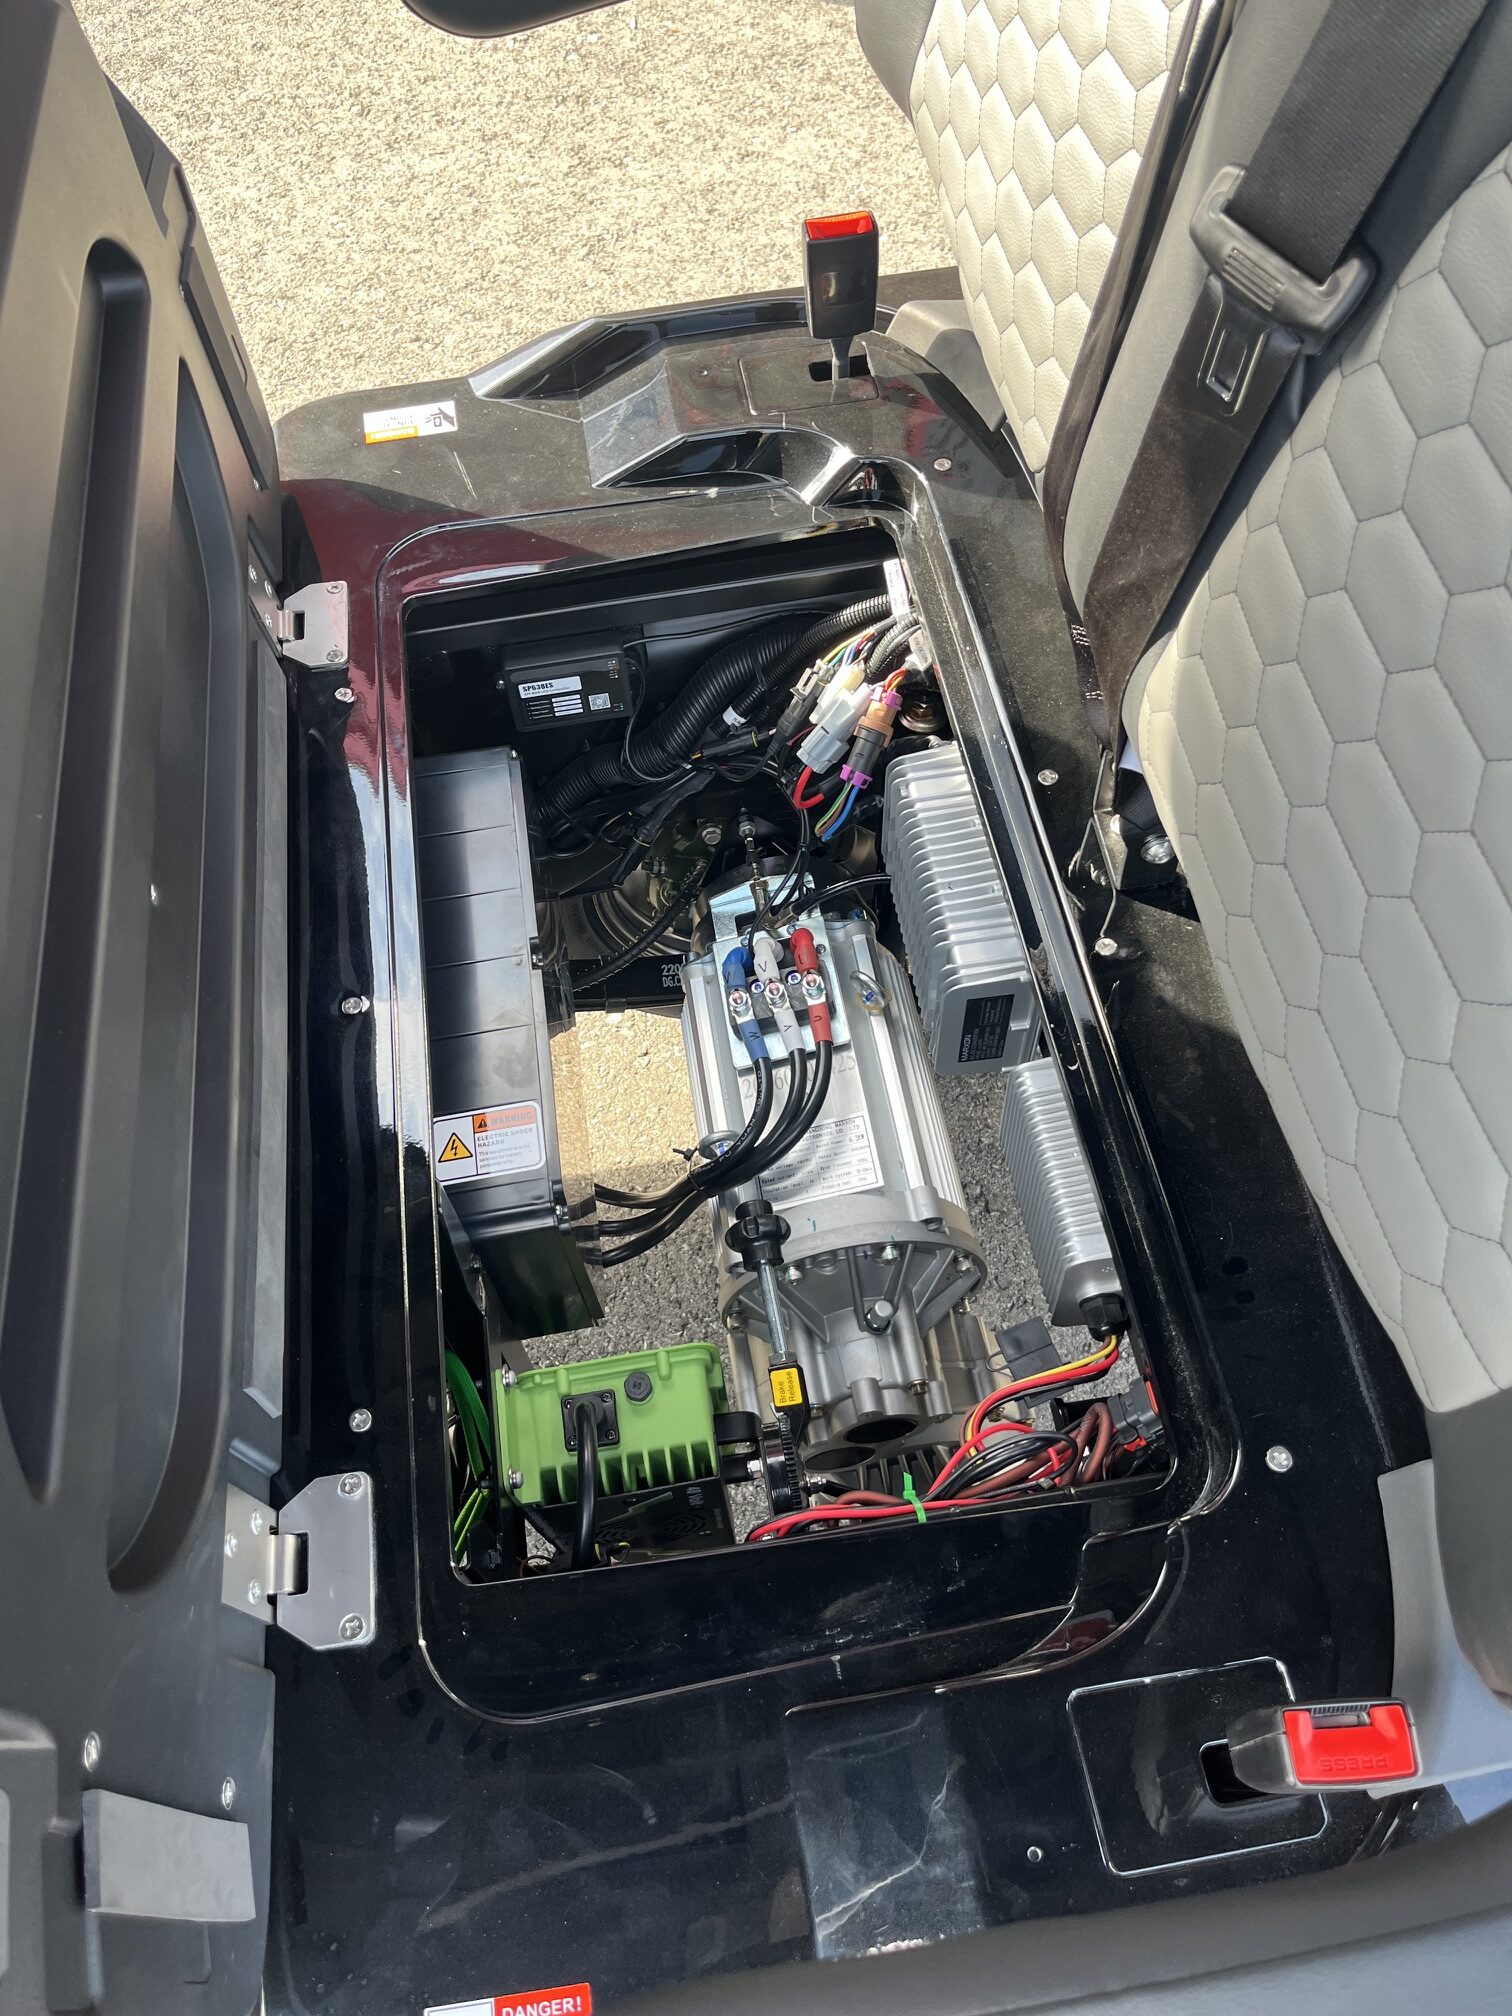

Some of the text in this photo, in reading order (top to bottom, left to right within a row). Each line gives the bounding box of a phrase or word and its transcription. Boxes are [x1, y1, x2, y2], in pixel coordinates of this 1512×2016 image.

[757, 960, 767, 973] V
[813, 1015, 823, 1023] U
[491, 1112, 533, 1126] WARNING
[477, 1127, 534, 1142] ELECTRIC SHOCK
[477, 1139, 505, 1148] HAZARD
[778, 1381, 787, 1404] Brake
[786, 1371, 796, 1402] Release
[1319, 1754, 1389, 1773] PRESS
[501, 1995, 583, 2016] DANGER!
